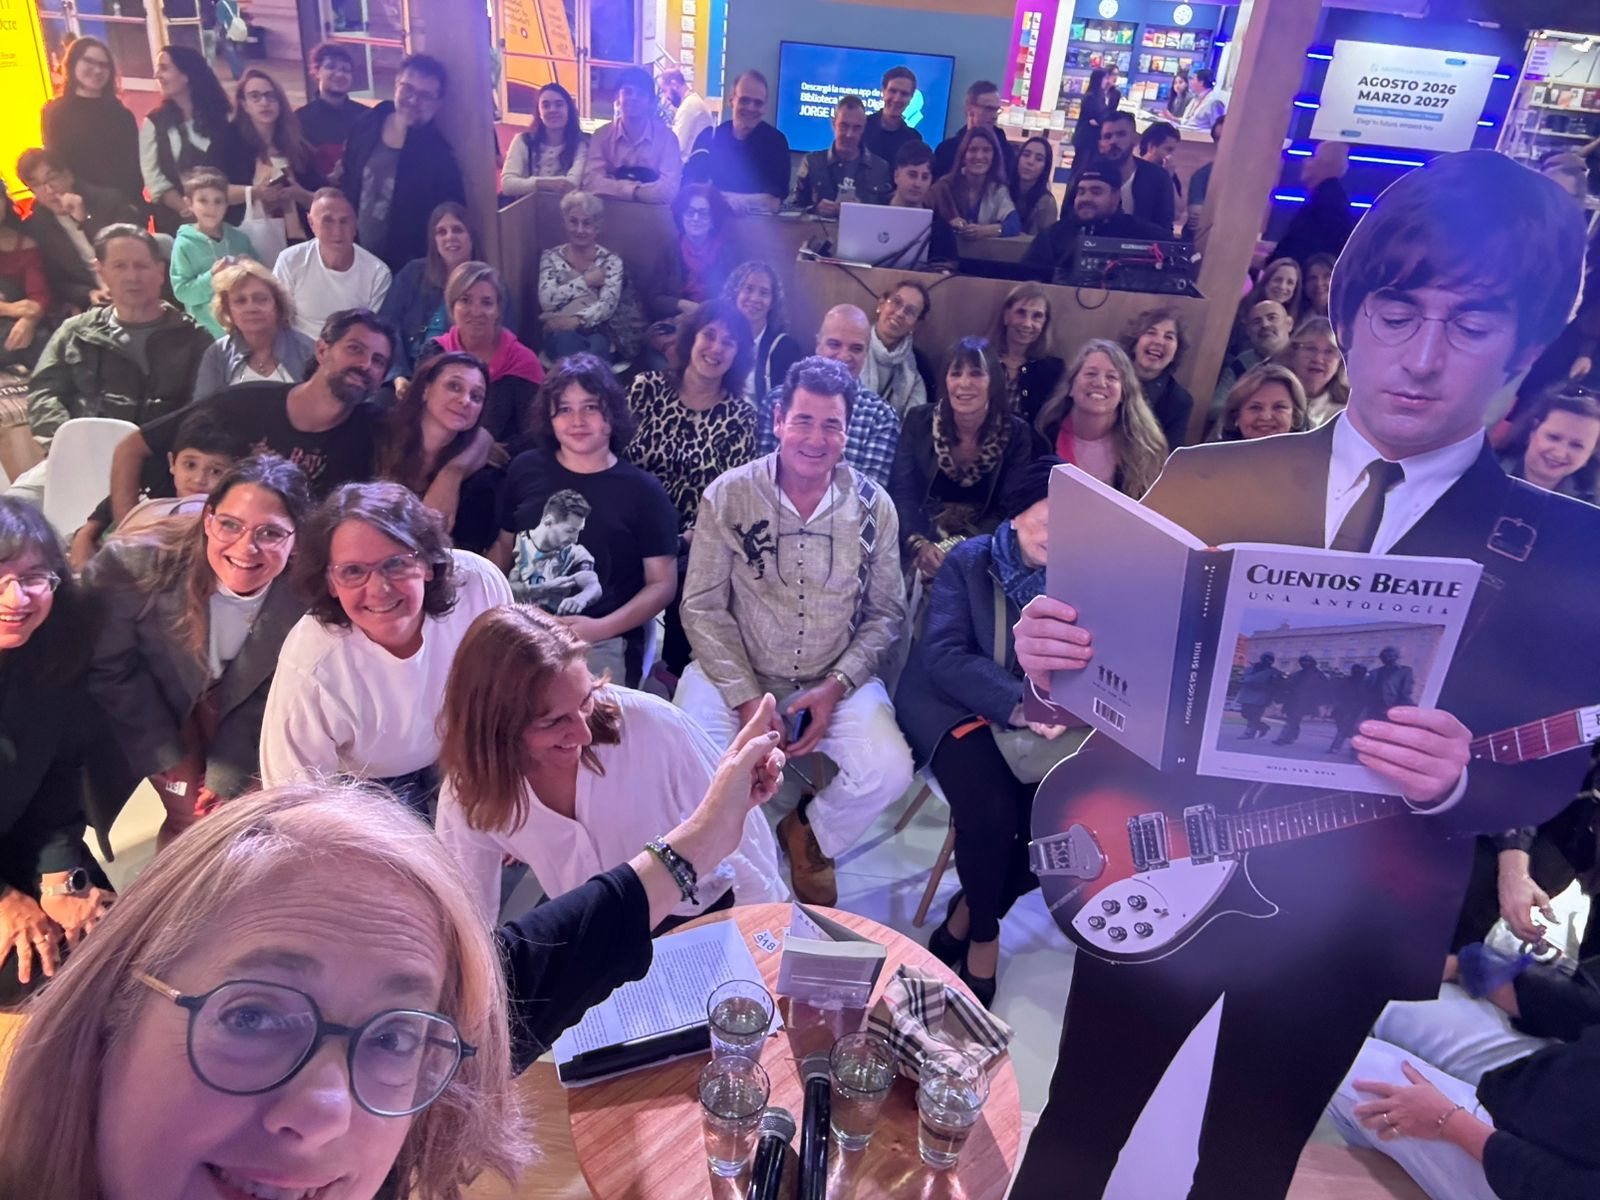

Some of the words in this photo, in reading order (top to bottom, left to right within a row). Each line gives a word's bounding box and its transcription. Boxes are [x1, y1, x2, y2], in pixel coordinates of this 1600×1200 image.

[1358, 76, 1419, 91] AGOSTO
[1422, 82, 1457, 95] 2026
[800, 92, 838, 105] Biblioteca
[859, 89, 871, 98] app
[1358, 90, 1411, 104] MARZO
[1414, 95, 1449, 108] 2027
[799, 104, 830, 118] JORGE
[1246, 563, 1361, 592] CUENTOS
[1369, 572, 1463, 599] BEATLE
[1248, 592, 1291, 602] UNA
